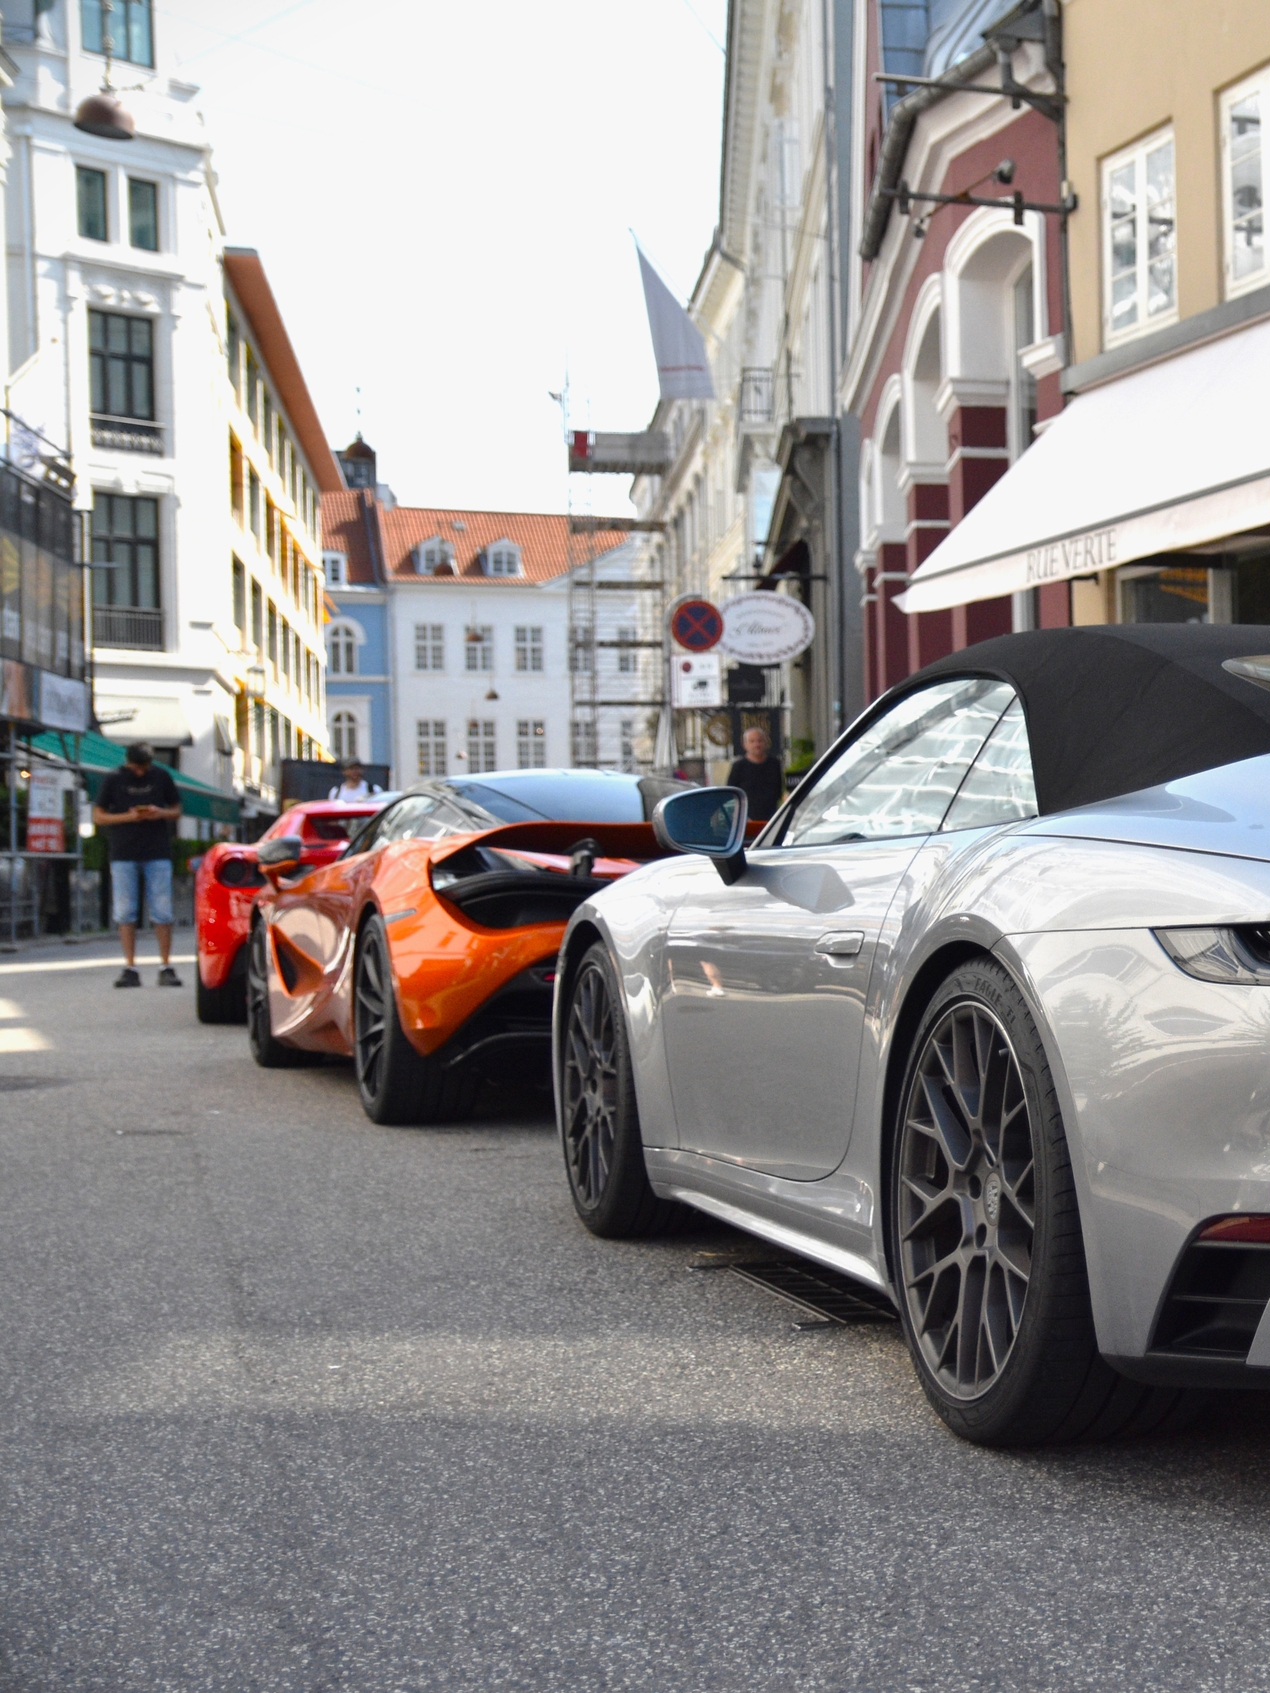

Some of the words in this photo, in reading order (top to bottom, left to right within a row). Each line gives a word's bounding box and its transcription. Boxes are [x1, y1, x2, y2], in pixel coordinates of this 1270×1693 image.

[1027, 545, 1060, 583] RUE
[1062, 529, 1117, 570] VERTE
[974, 978, 1002, 1005] EAGLE
